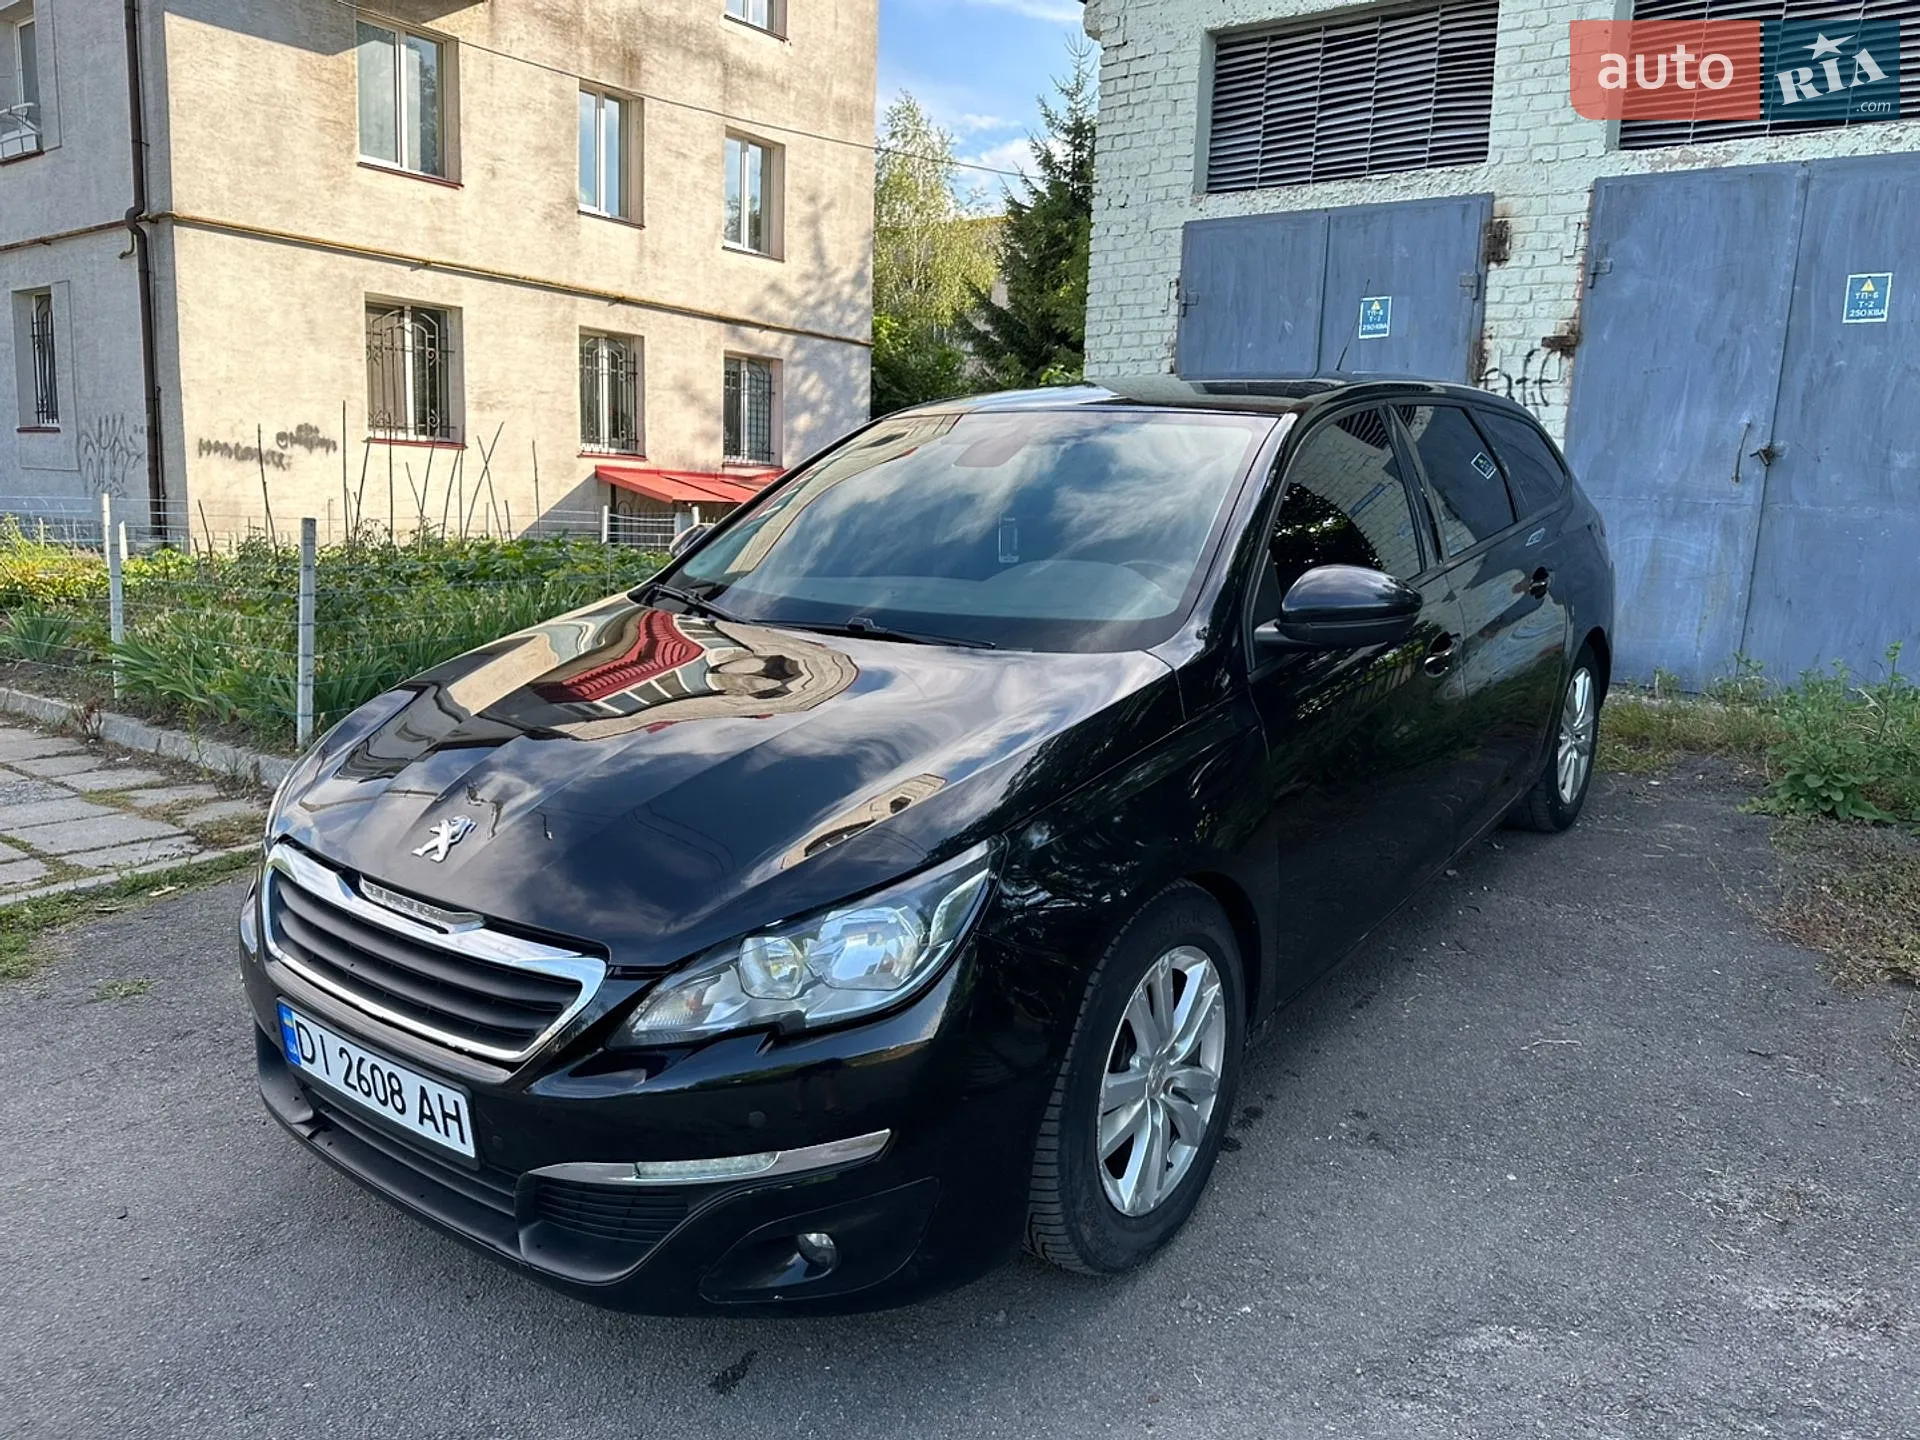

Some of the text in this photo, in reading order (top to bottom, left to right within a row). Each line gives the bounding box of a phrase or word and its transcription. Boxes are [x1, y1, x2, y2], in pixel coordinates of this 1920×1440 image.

[295, 1020, 467, 1145] DI 2608 AH
